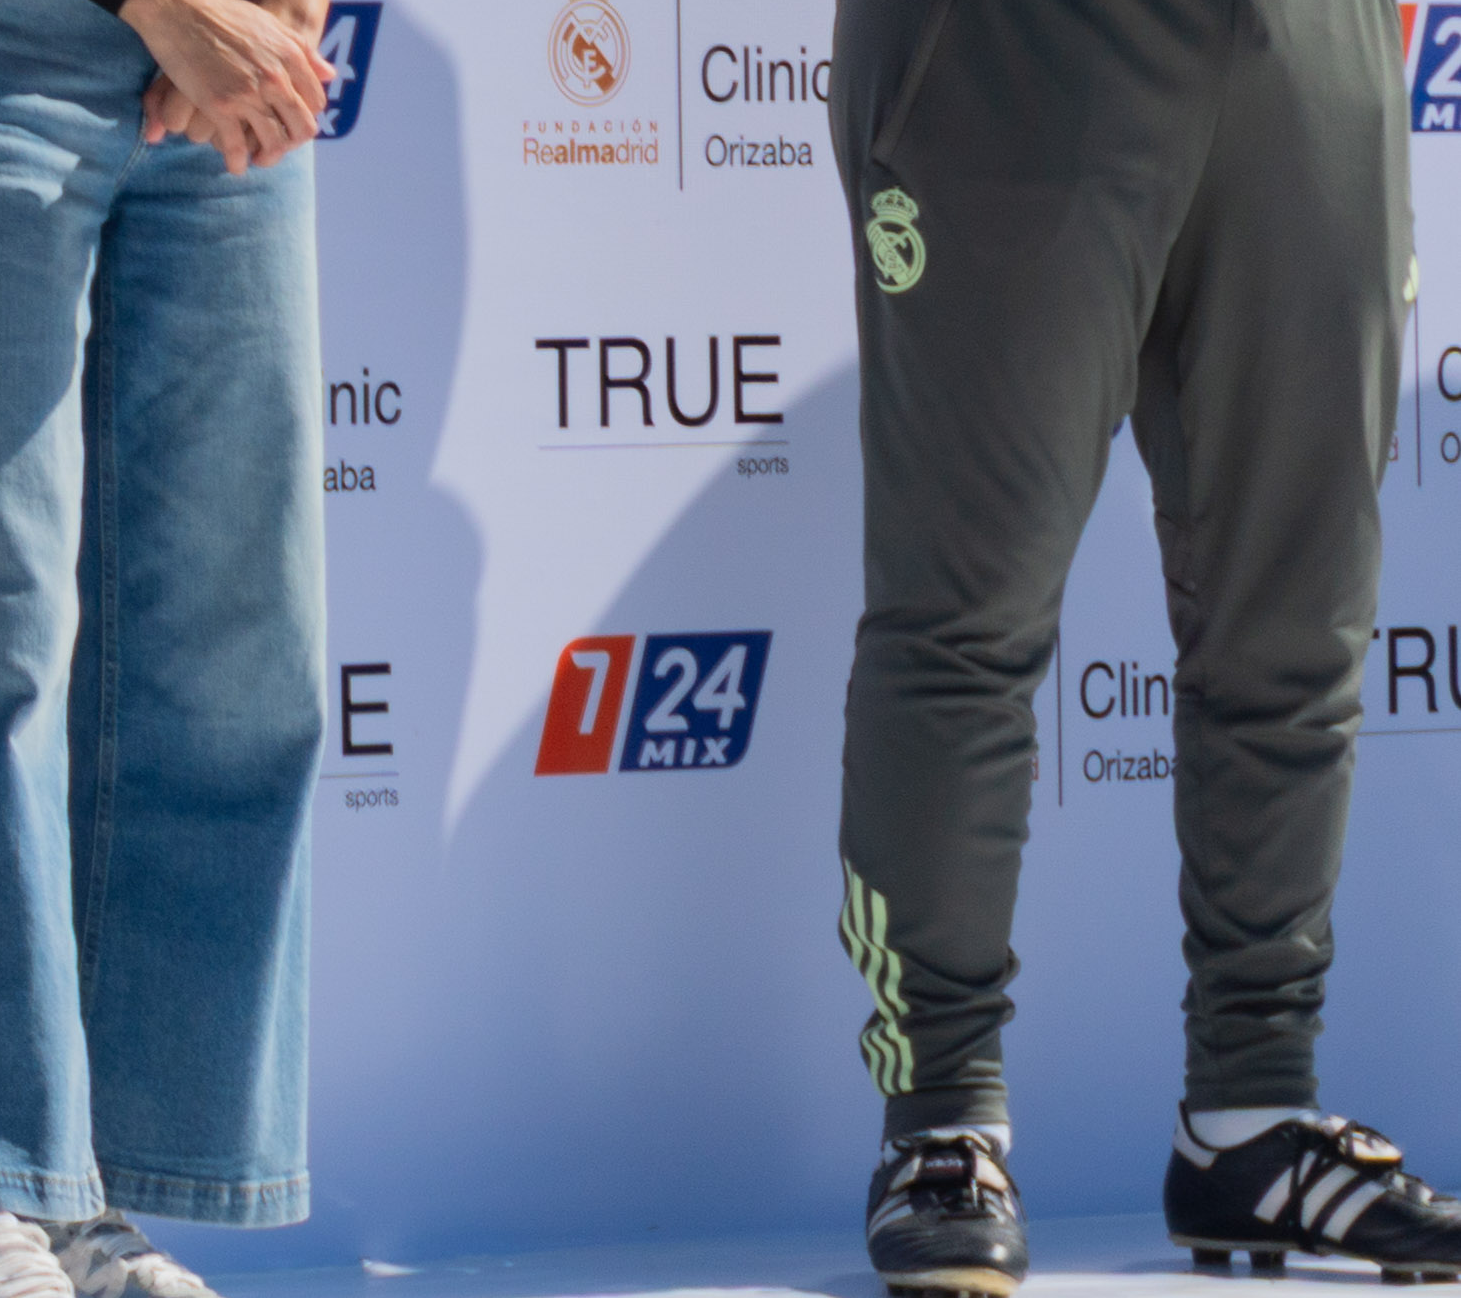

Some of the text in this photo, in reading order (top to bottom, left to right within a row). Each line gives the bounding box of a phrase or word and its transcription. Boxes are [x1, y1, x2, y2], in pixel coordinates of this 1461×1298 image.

[524, 138, 658, 164] Realmadrid
[705, 134, 813, 166] Orizaba
[536, 335, 784, 428] TRUE
[736, 456, 789, 478] sports
[644, 644, 747, 734] 24
[639, 738, 731, 766] MIX
[1084, 749, 1174, 781] Orizab
[345, 788, 399, 811] sports
